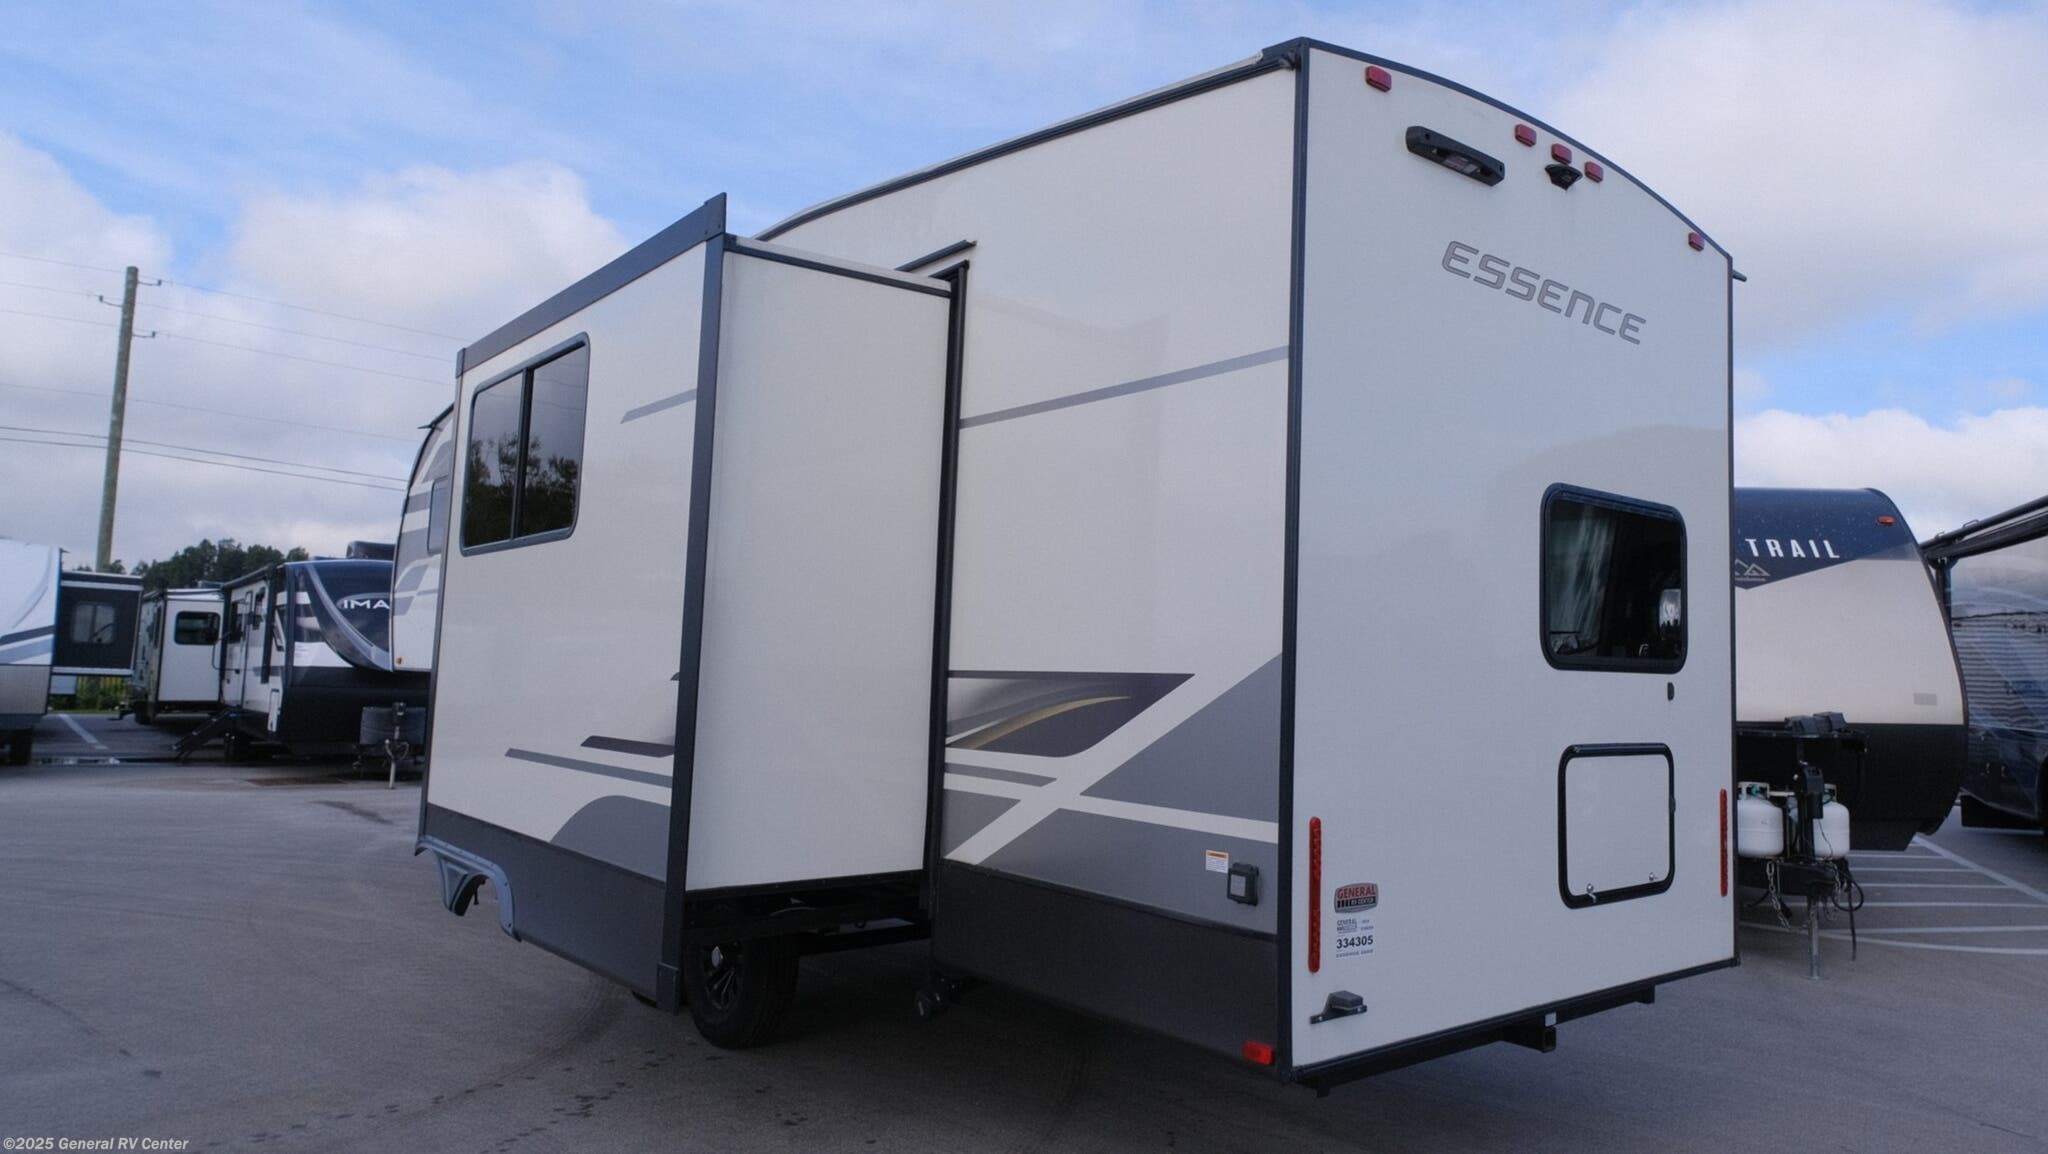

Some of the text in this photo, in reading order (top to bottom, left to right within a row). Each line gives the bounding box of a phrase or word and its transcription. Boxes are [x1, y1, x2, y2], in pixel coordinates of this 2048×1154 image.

[1441, 240, 1647, 345] ESSENCE
[1745, 538, 1840, 559] TRAIL
[1337, 885, 1376, 899] GENERAL
[1336, 935, 1374, 949] 334305
